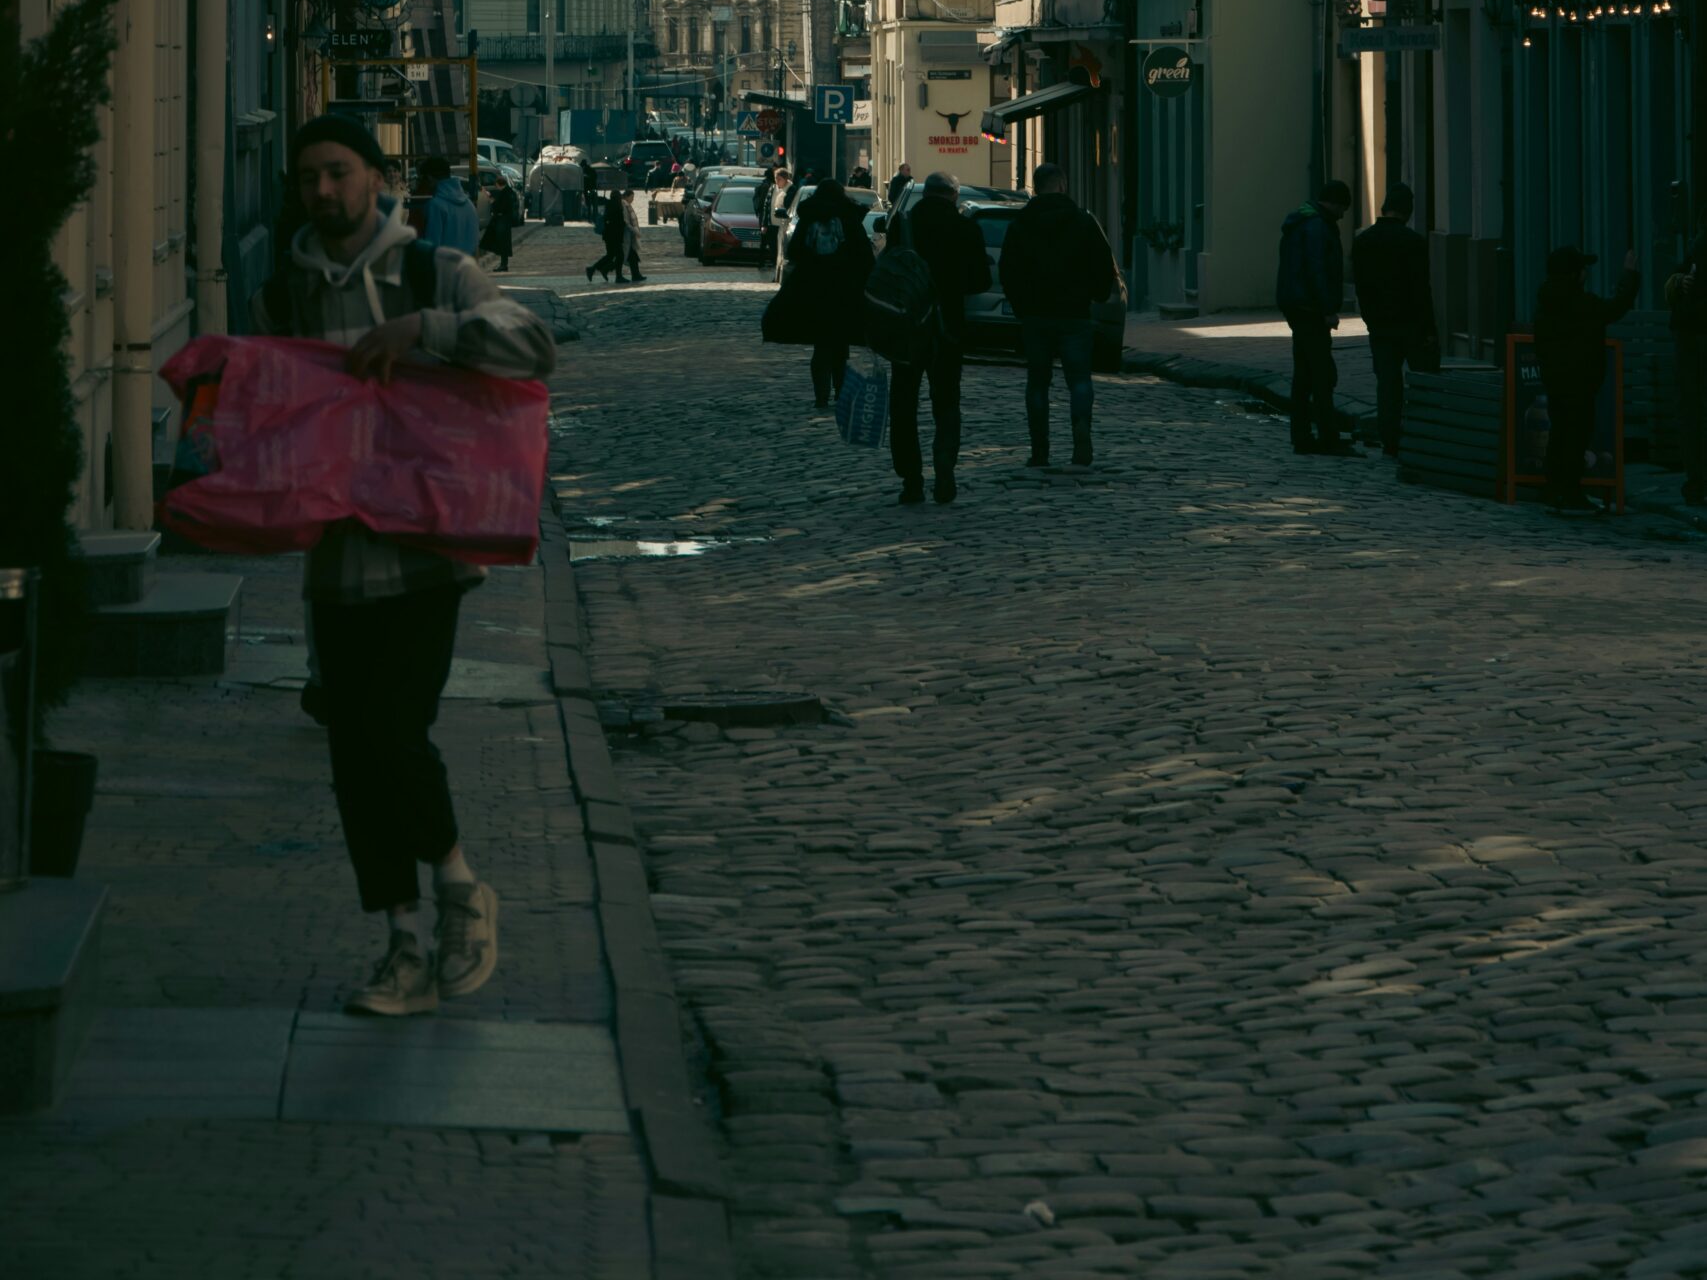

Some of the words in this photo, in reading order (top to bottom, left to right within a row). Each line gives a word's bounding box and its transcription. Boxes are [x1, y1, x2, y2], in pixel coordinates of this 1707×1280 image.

[1148, 66, 1190, 85] green
[824, 90, 845, 119] P
[928, 135, 961, 145] SMOKED
[858, 383, 879, 443] MIGROS
